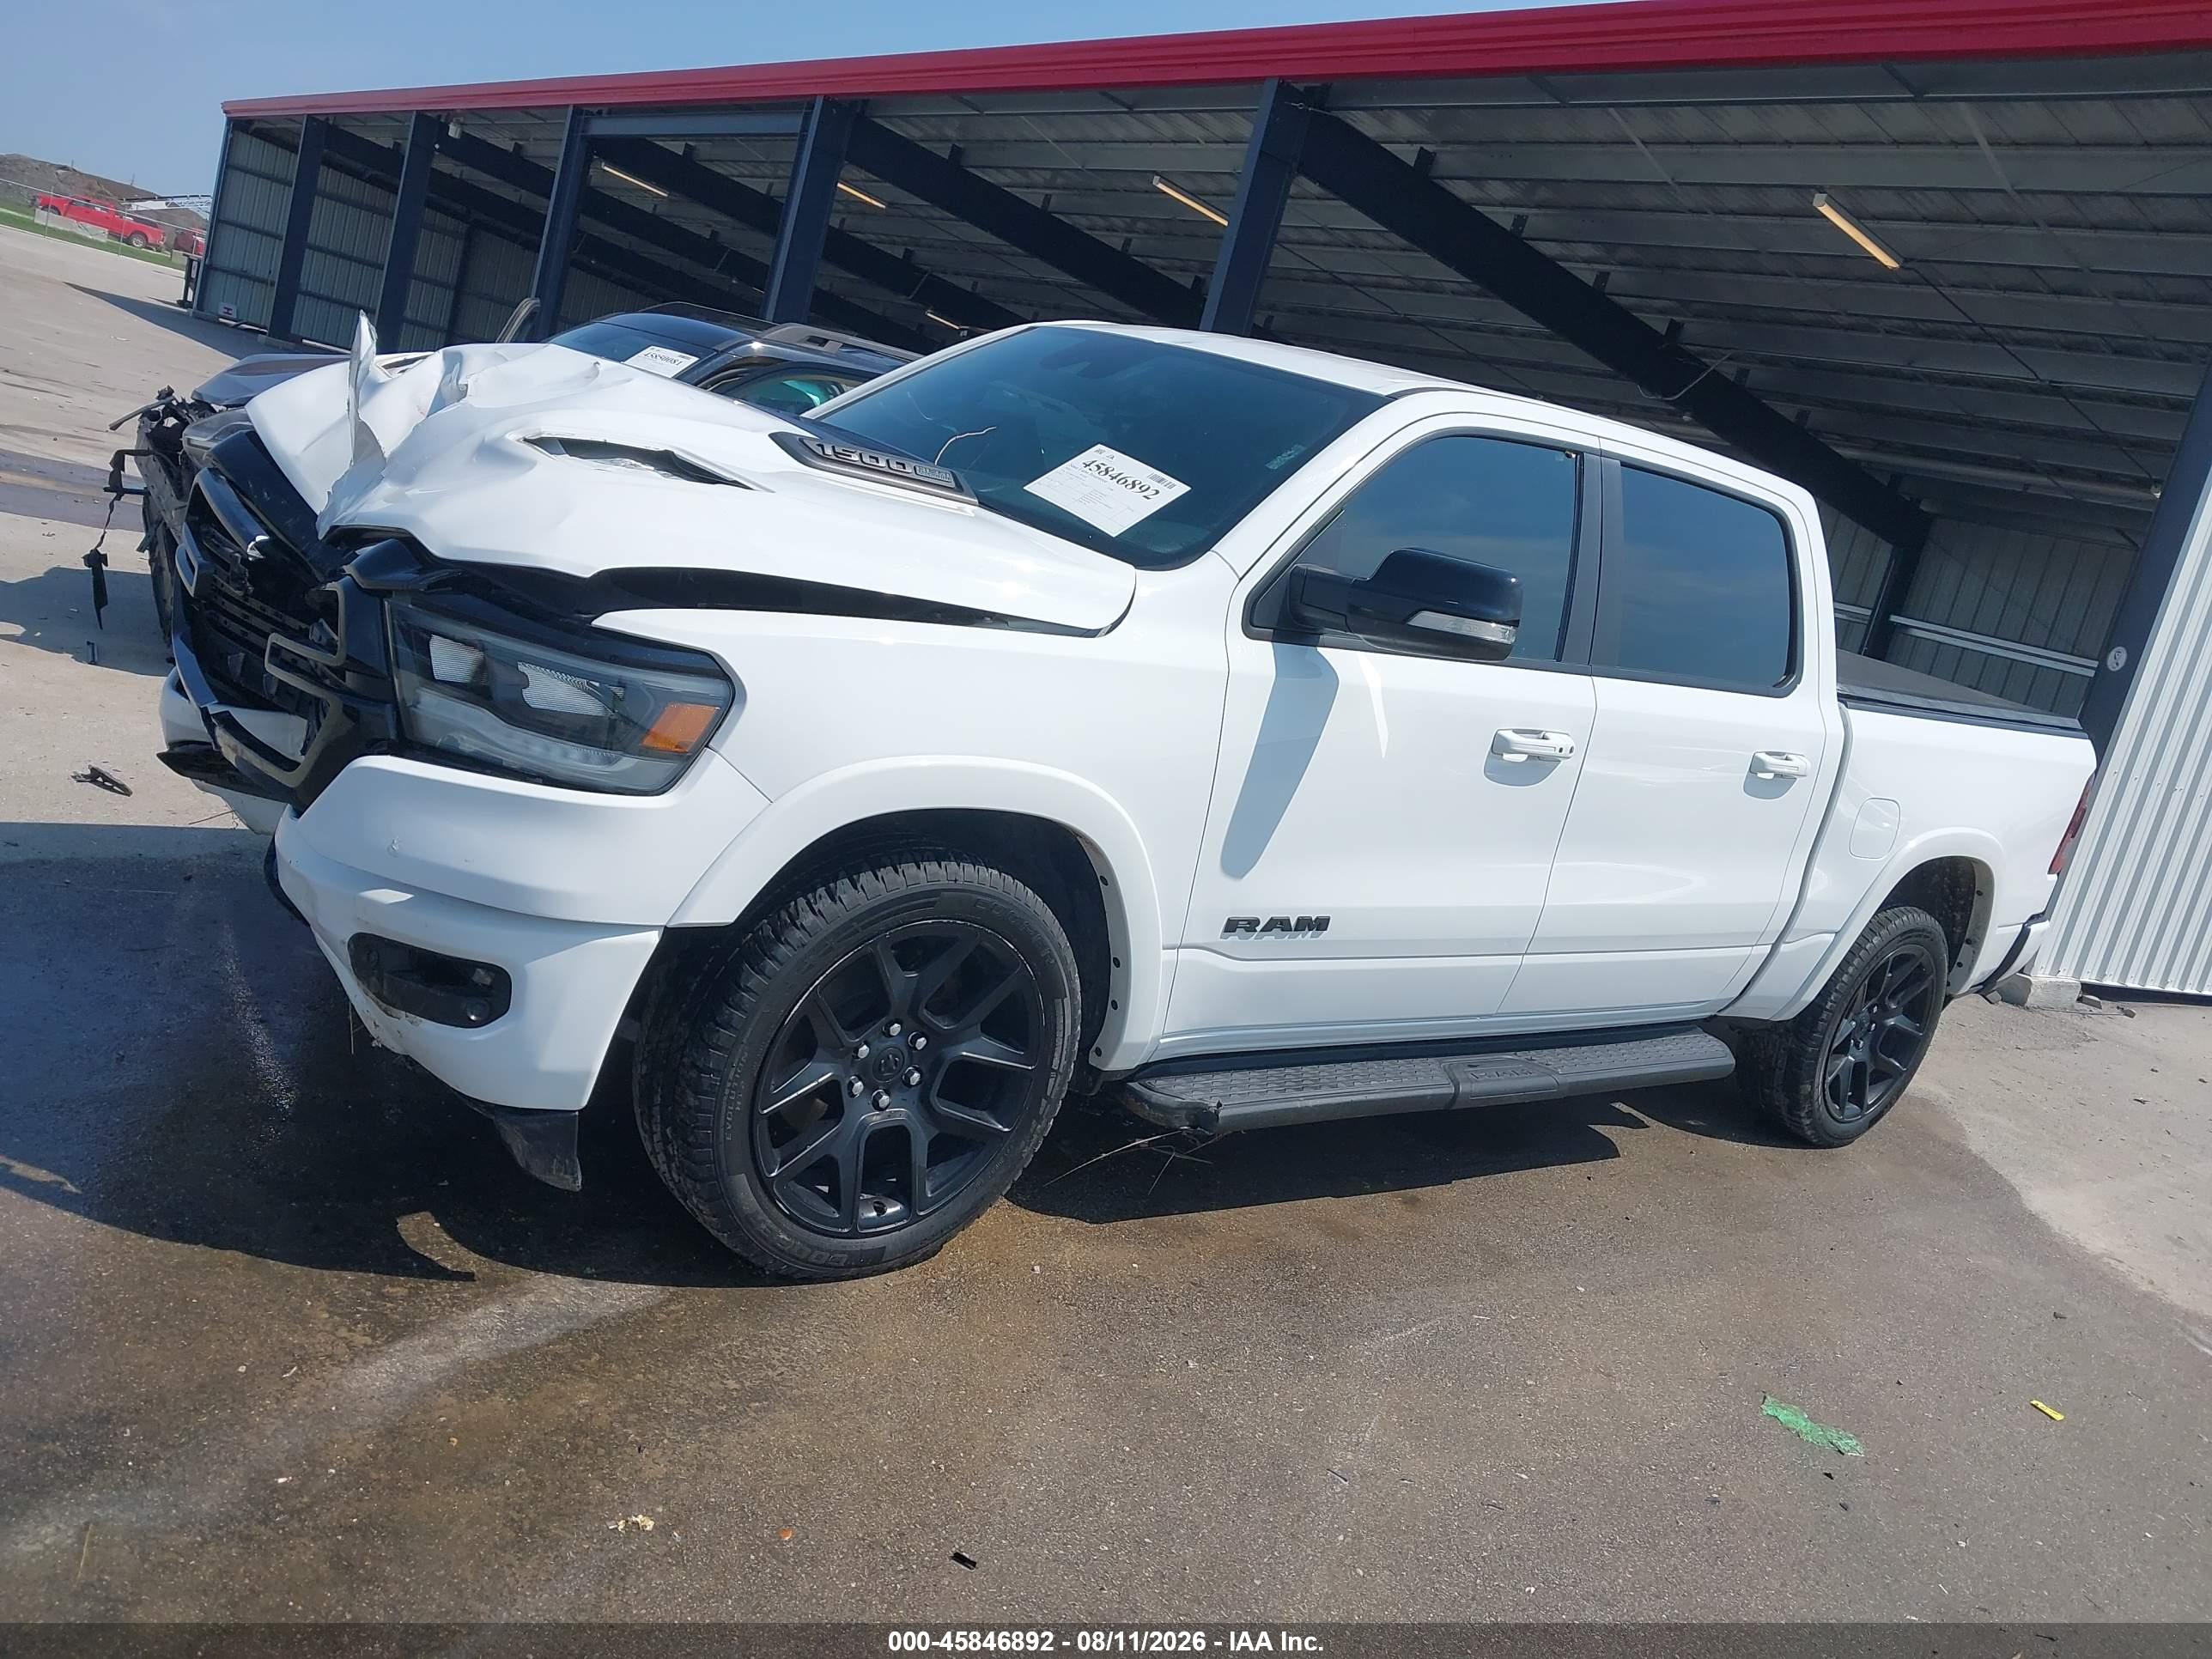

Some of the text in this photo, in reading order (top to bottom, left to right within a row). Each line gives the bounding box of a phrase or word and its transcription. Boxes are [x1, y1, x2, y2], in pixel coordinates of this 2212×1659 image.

[816, 442, 913, 474] 1500
[1082, 459, 1160, 501] 45846892
[1223, 915, 1331, 934] RAM
